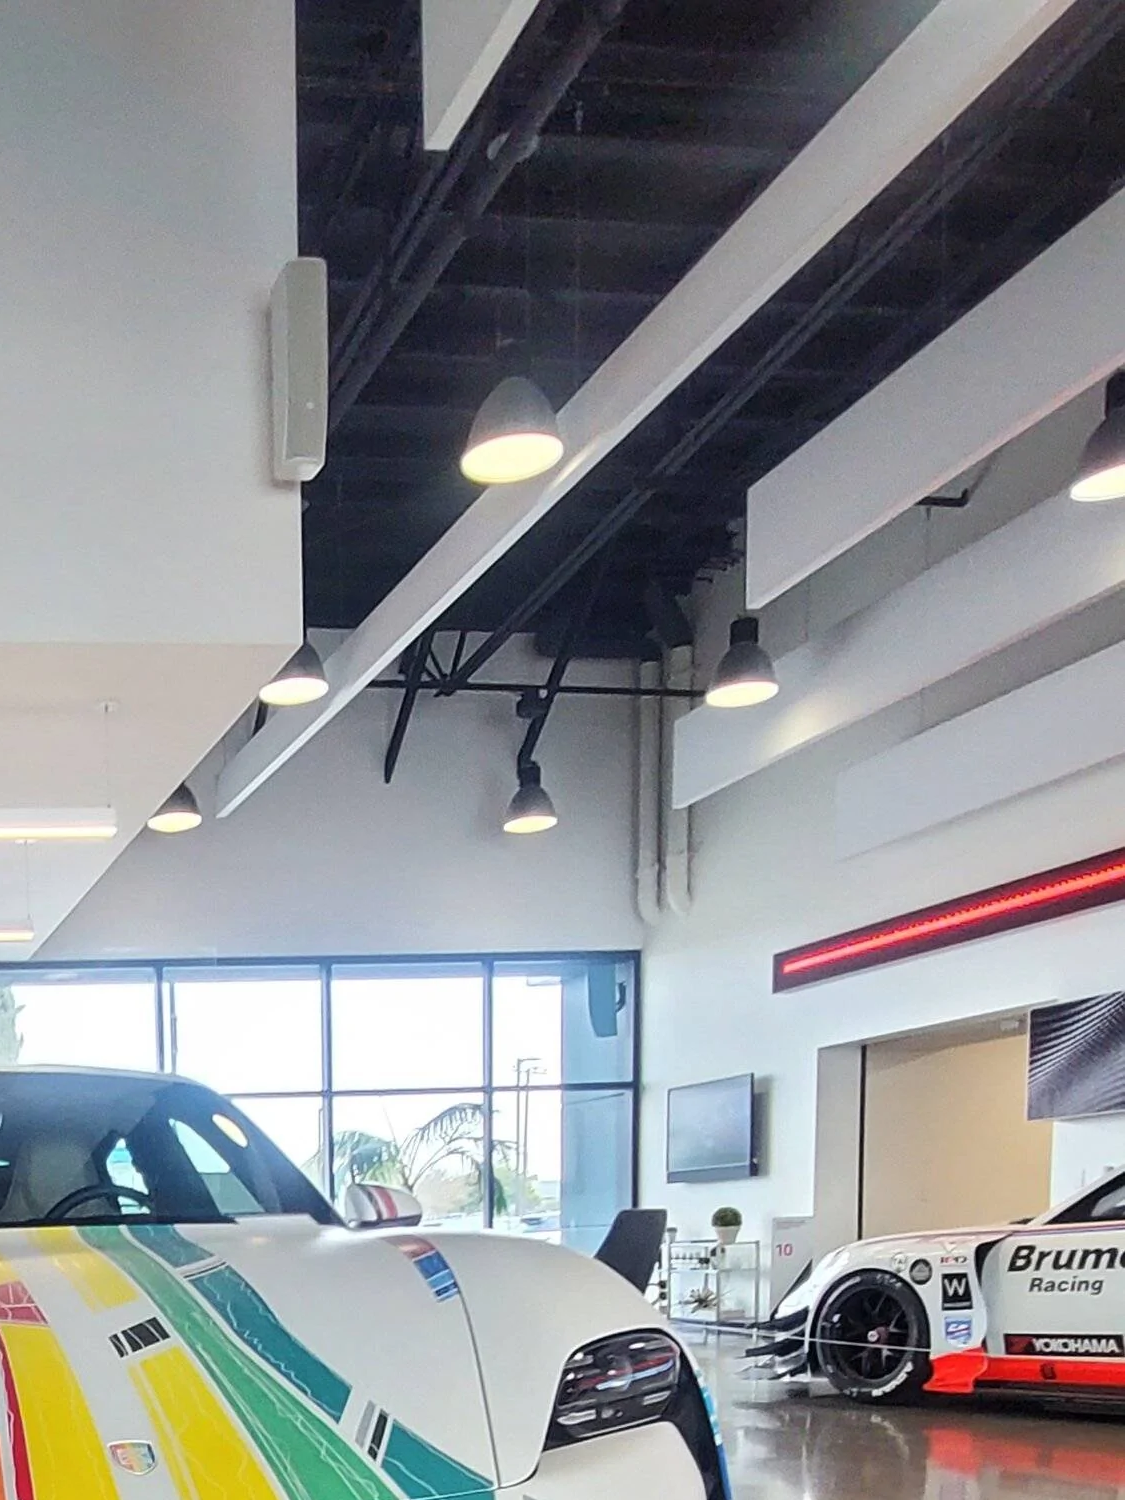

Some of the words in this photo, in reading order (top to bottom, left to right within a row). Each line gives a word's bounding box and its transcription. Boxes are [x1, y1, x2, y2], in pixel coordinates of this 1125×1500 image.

[775, 1243, 793, 1257] 10
[944, 1277, 967, 1297] W
[1028, 1276, 1104, 1295] Racing
[1032, 1337, 1121, 1354] YOKOHAMA
